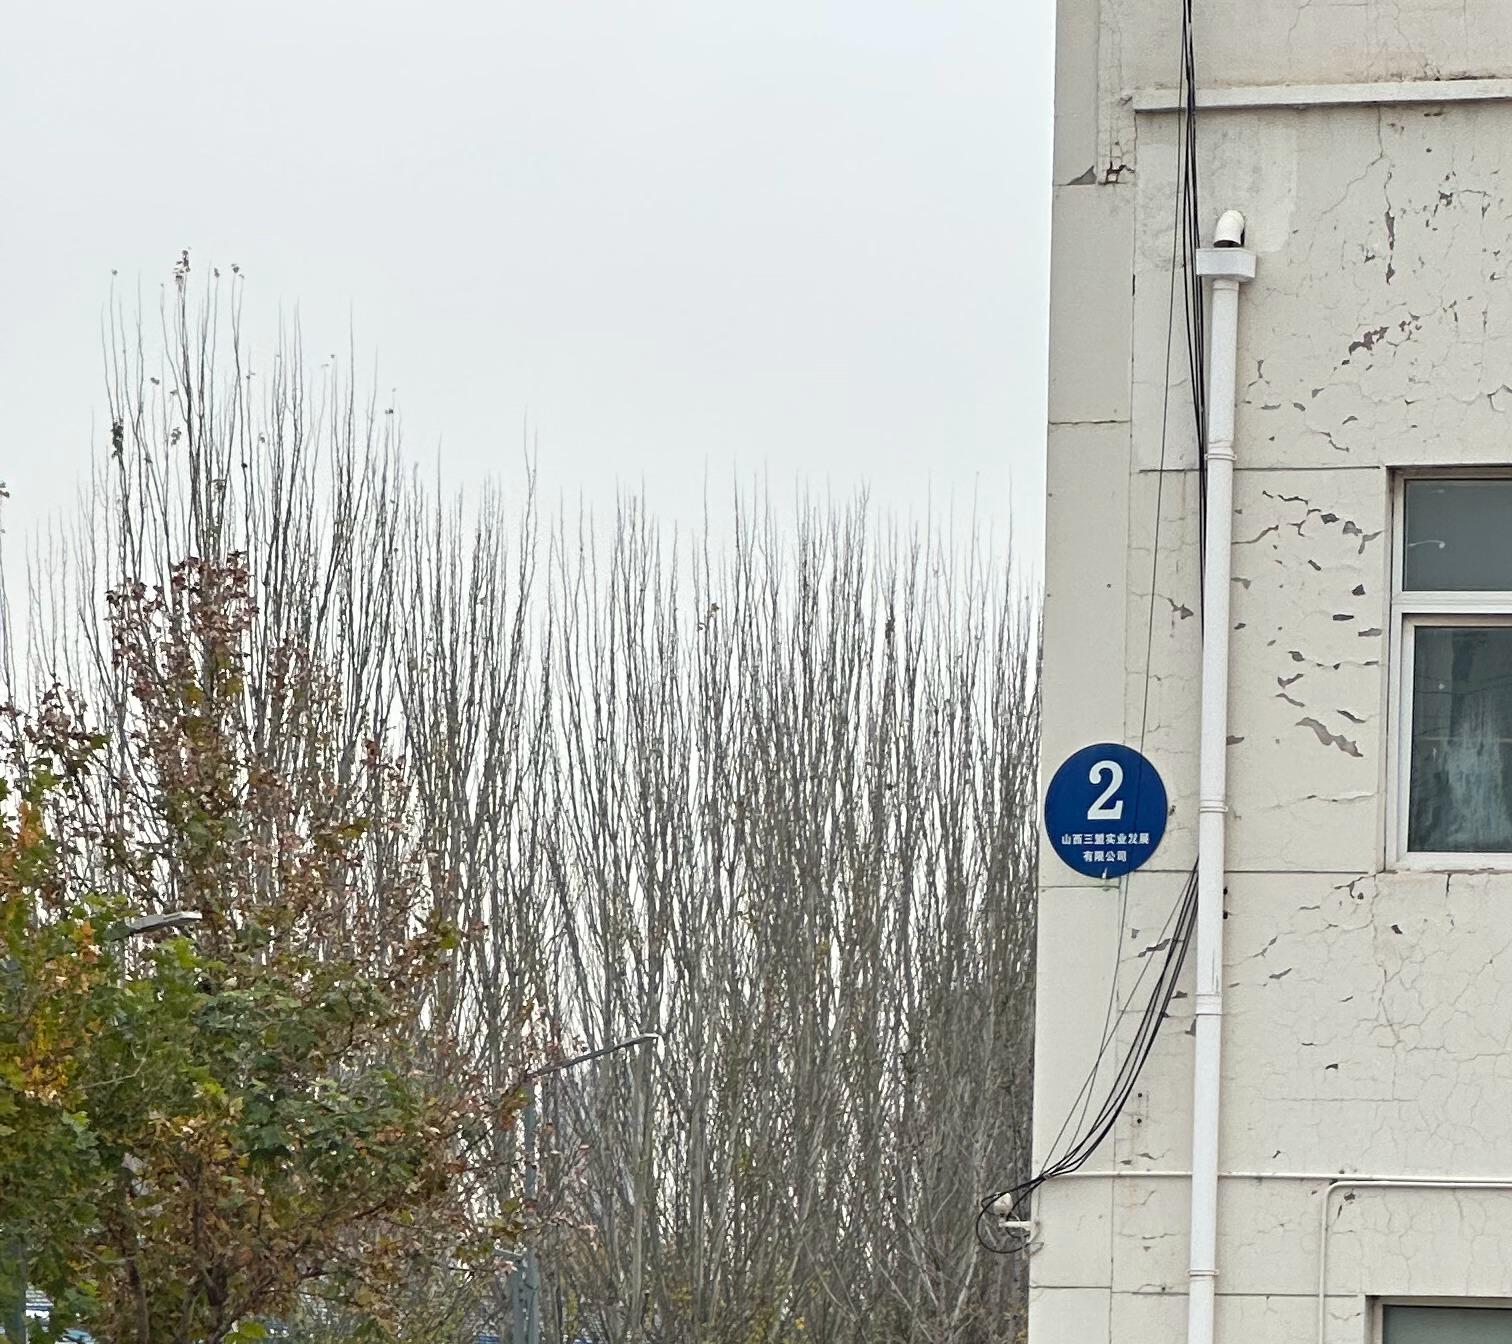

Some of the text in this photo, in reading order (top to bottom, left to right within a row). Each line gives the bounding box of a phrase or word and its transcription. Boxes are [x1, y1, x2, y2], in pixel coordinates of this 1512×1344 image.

[1087, 760, 1124, 820] 2
[1083, 850, 1127, 862] 有限公司
